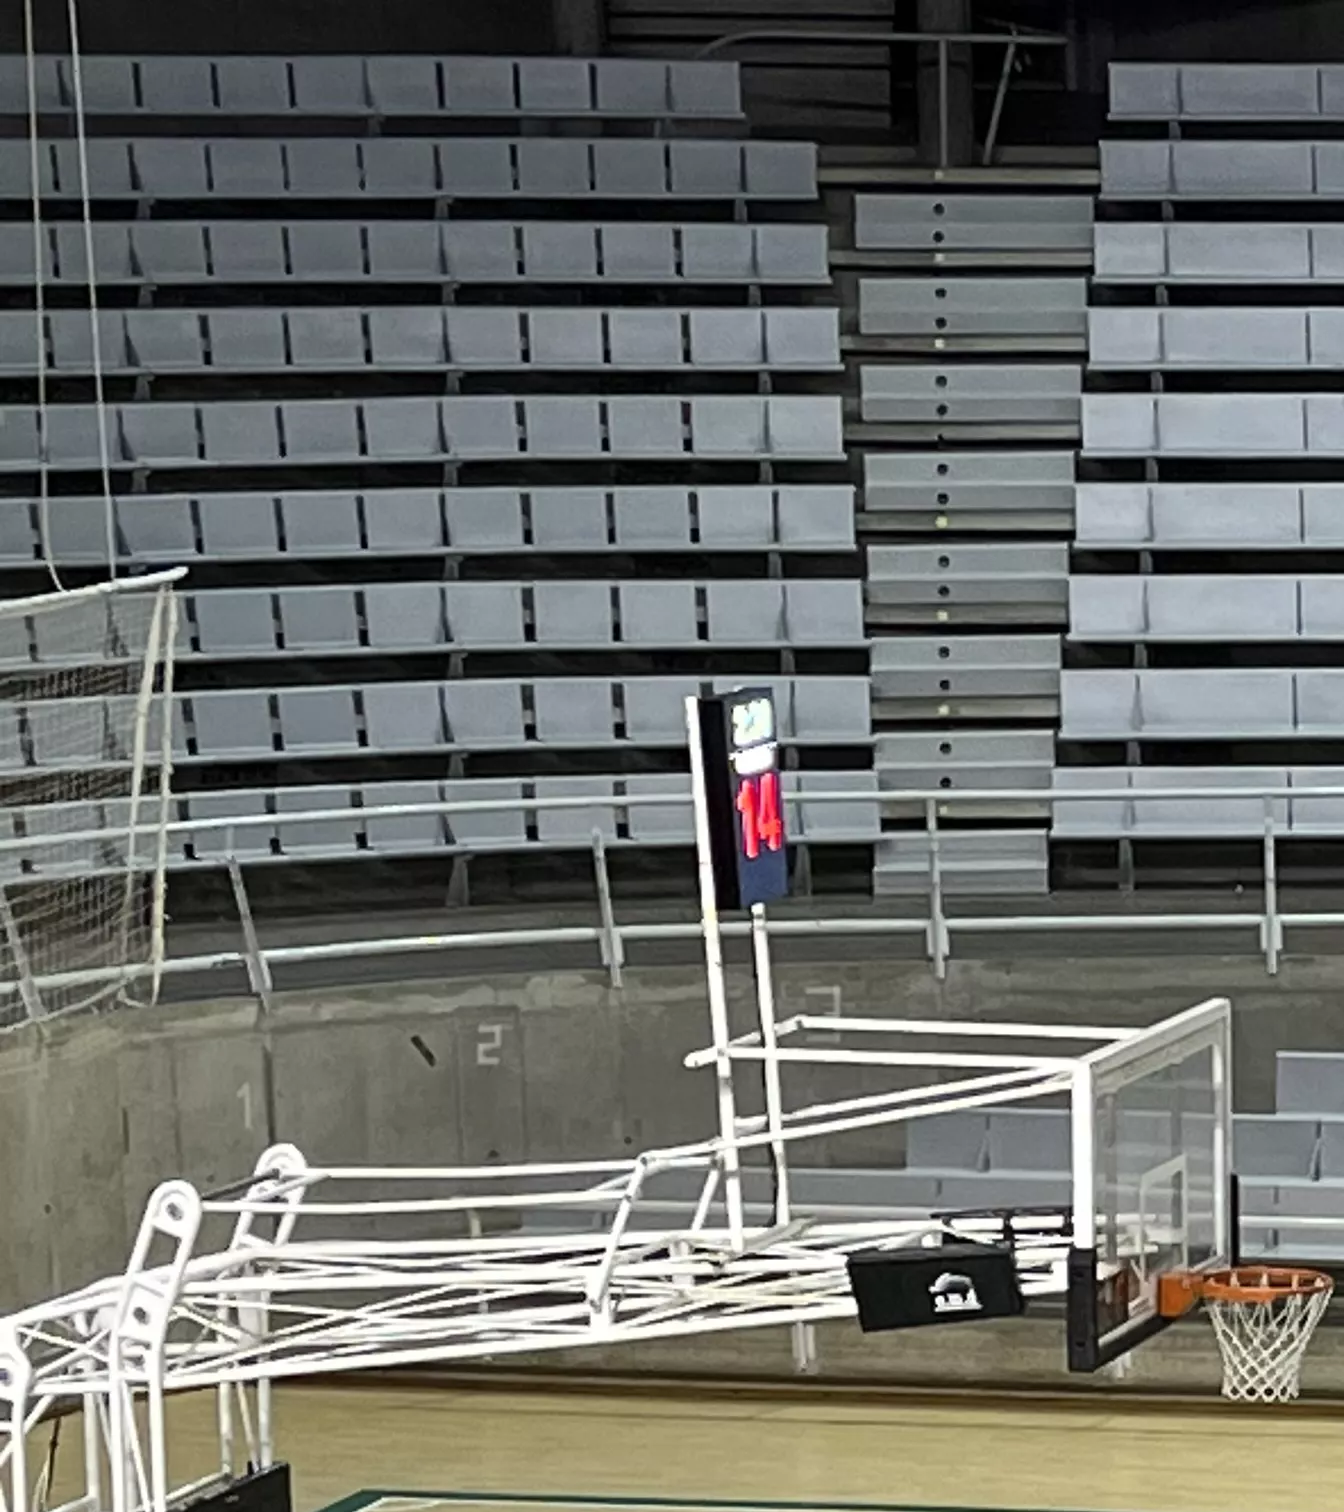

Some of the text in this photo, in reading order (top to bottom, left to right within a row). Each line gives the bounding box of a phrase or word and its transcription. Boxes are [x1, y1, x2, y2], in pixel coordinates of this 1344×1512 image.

[736, 772, 783, 859] 14
[476, 1023, 502, 1066] 2
[236, 1081, 252, 1129] 1
